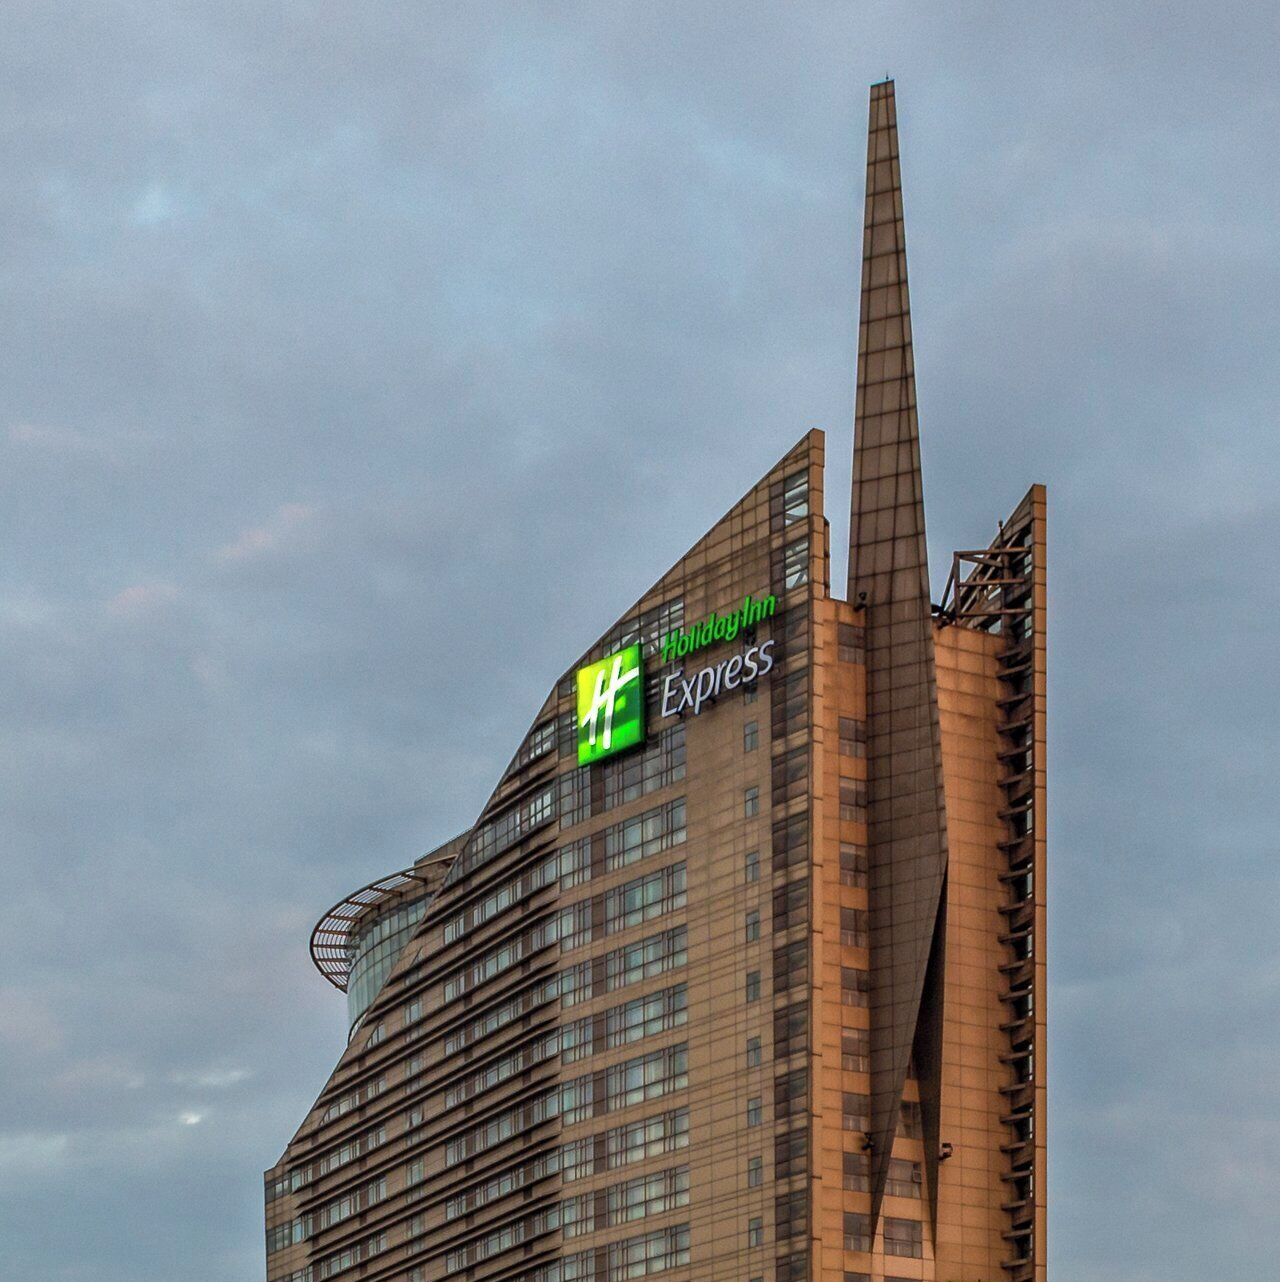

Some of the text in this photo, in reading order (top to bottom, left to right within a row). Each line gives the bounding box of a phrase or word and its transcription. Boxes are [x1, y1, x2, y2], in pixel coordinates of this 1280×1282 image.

[661, 595, 776, 663] Holiday Inn
[661, 640, 775, 718] Express
